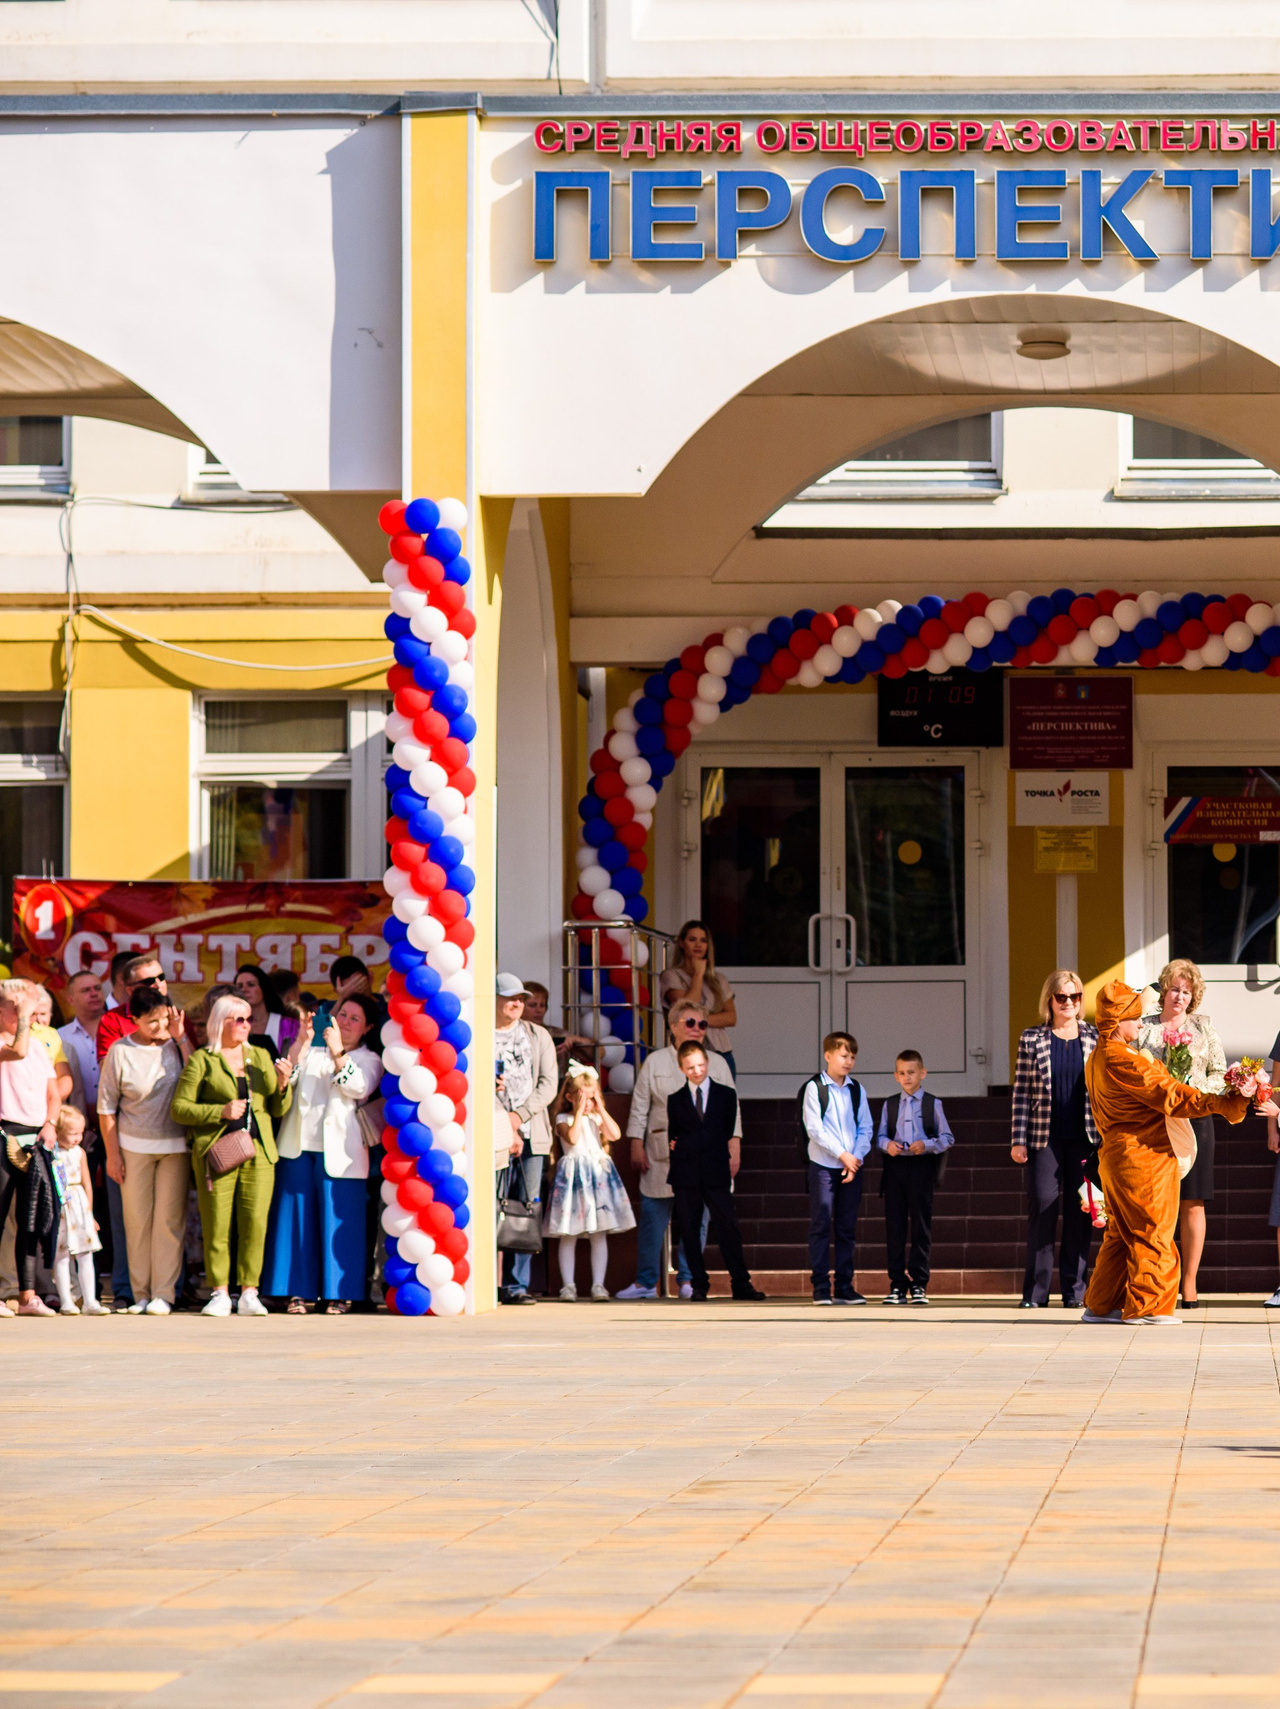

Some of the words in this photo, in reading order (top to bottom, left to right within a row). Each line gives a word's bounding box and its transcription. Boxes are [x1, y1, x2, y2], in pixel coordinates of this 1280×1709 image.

[533, 119, 743, 159] СРЕДНЯЯ
[889, 709, 919, 717] ВОЗДУХ
[1024, 789, 1055, 798] ТОЧКА
[1071, 789, 1100, 798] РОСТА
[1206, 801, 1273, 810] УЧАСТКОВАЯ
[1210, 818, 1268, 827] КОМИССИЯ
[34, 900, 56, 940] 1
[64, 931, 390, 983] СНТЯБР
